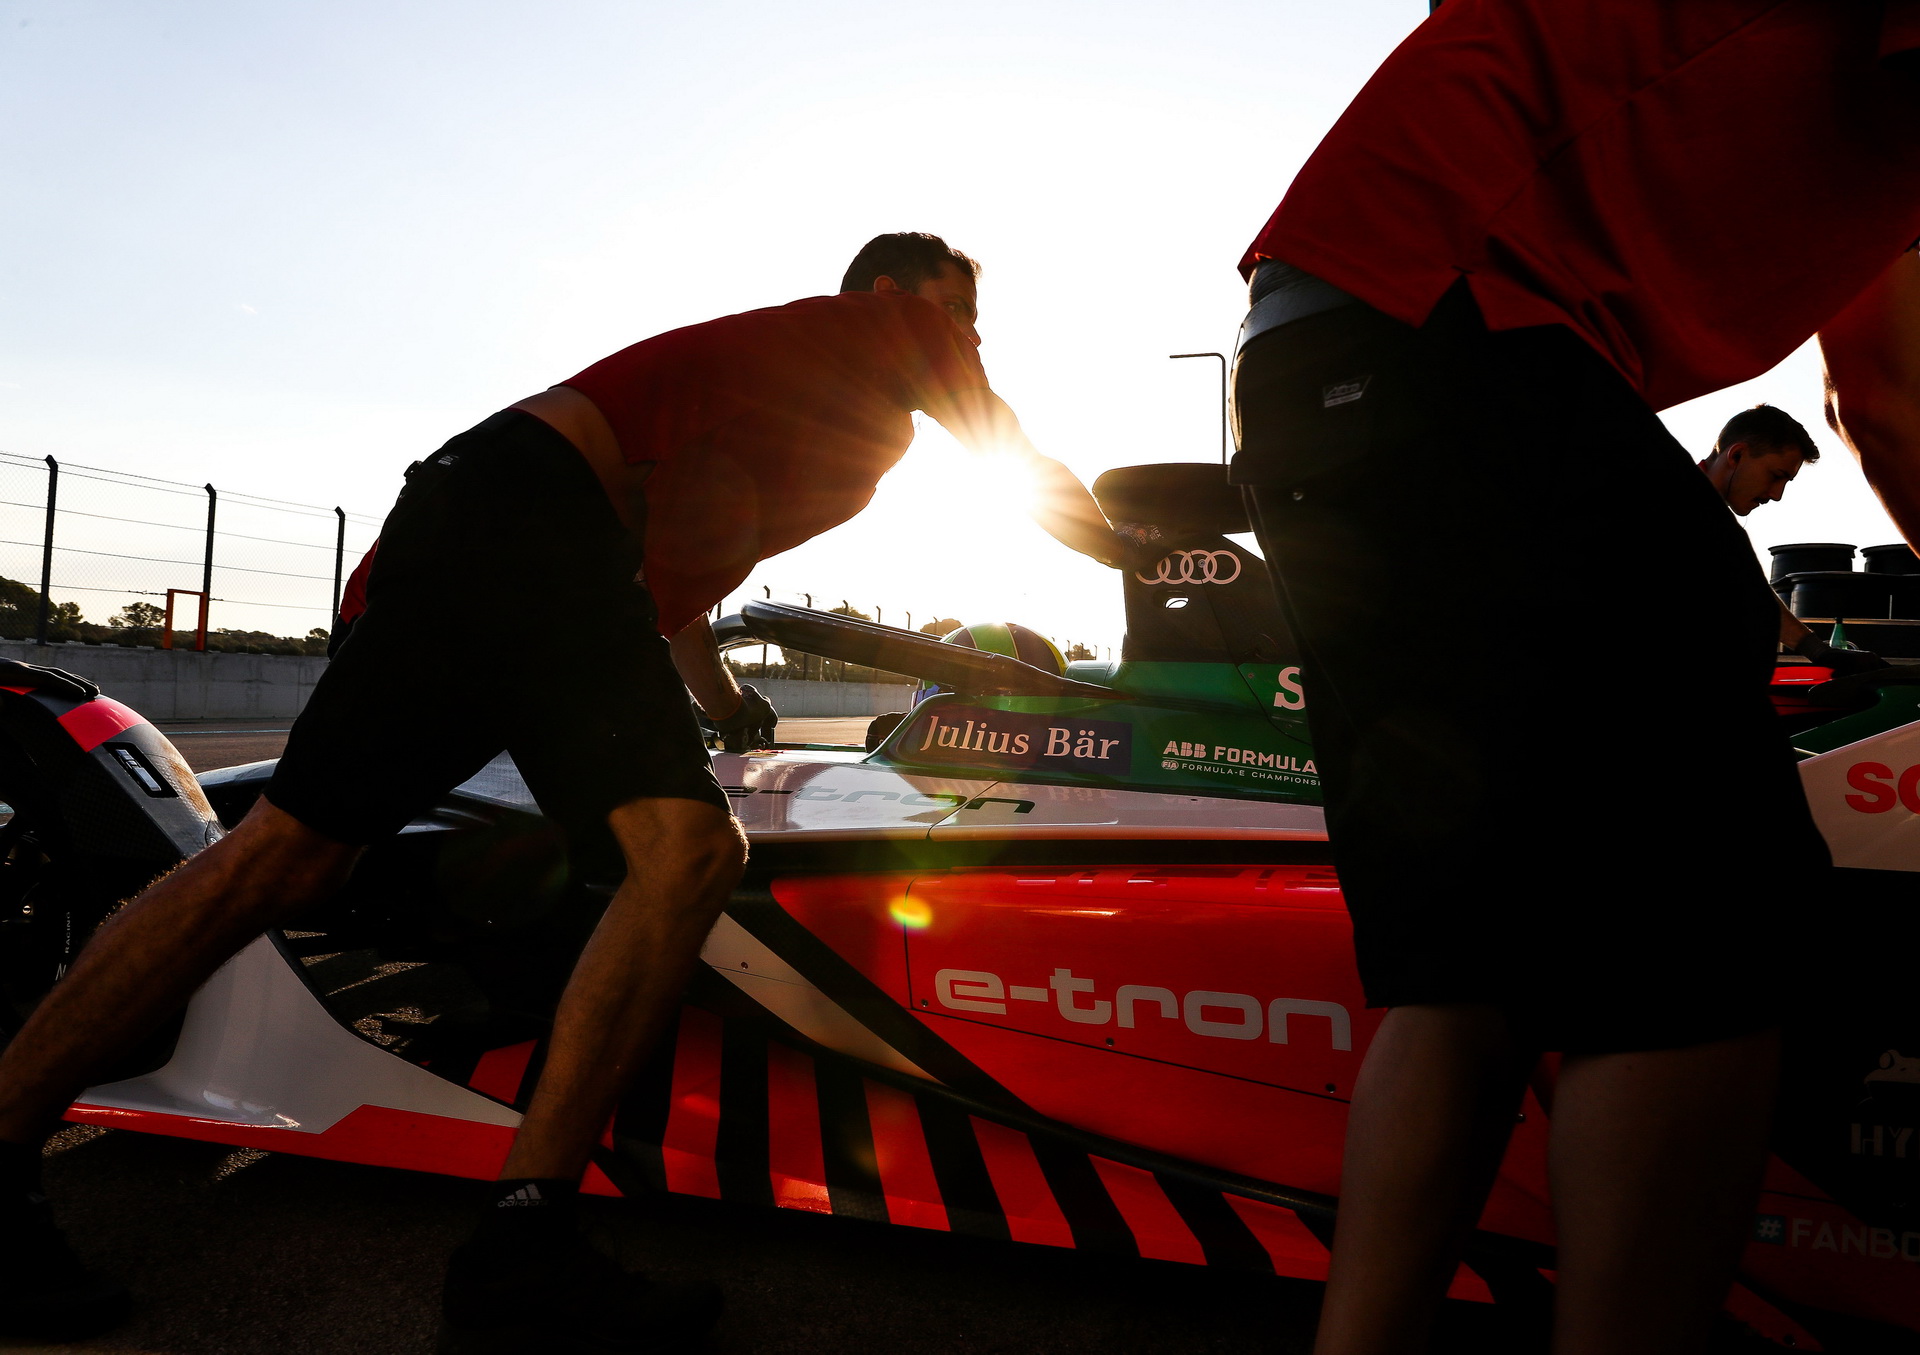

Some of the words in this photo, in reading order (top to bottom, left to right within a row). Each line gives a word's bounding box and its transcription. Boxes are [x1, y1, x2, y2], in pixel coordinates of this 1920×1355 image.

[1273, 666, 1306, 710] S
[920, 715, 1030, 755] Julius
[1044, 727, 1120, 760] Bär
[1163, 740, 1207, 759] ABB
[1214, 746, 1318, 775] FORMULA
[1182, 763, 1245, 777] FORMULA-E
[934, 967, 1352, 1052] e-tron
